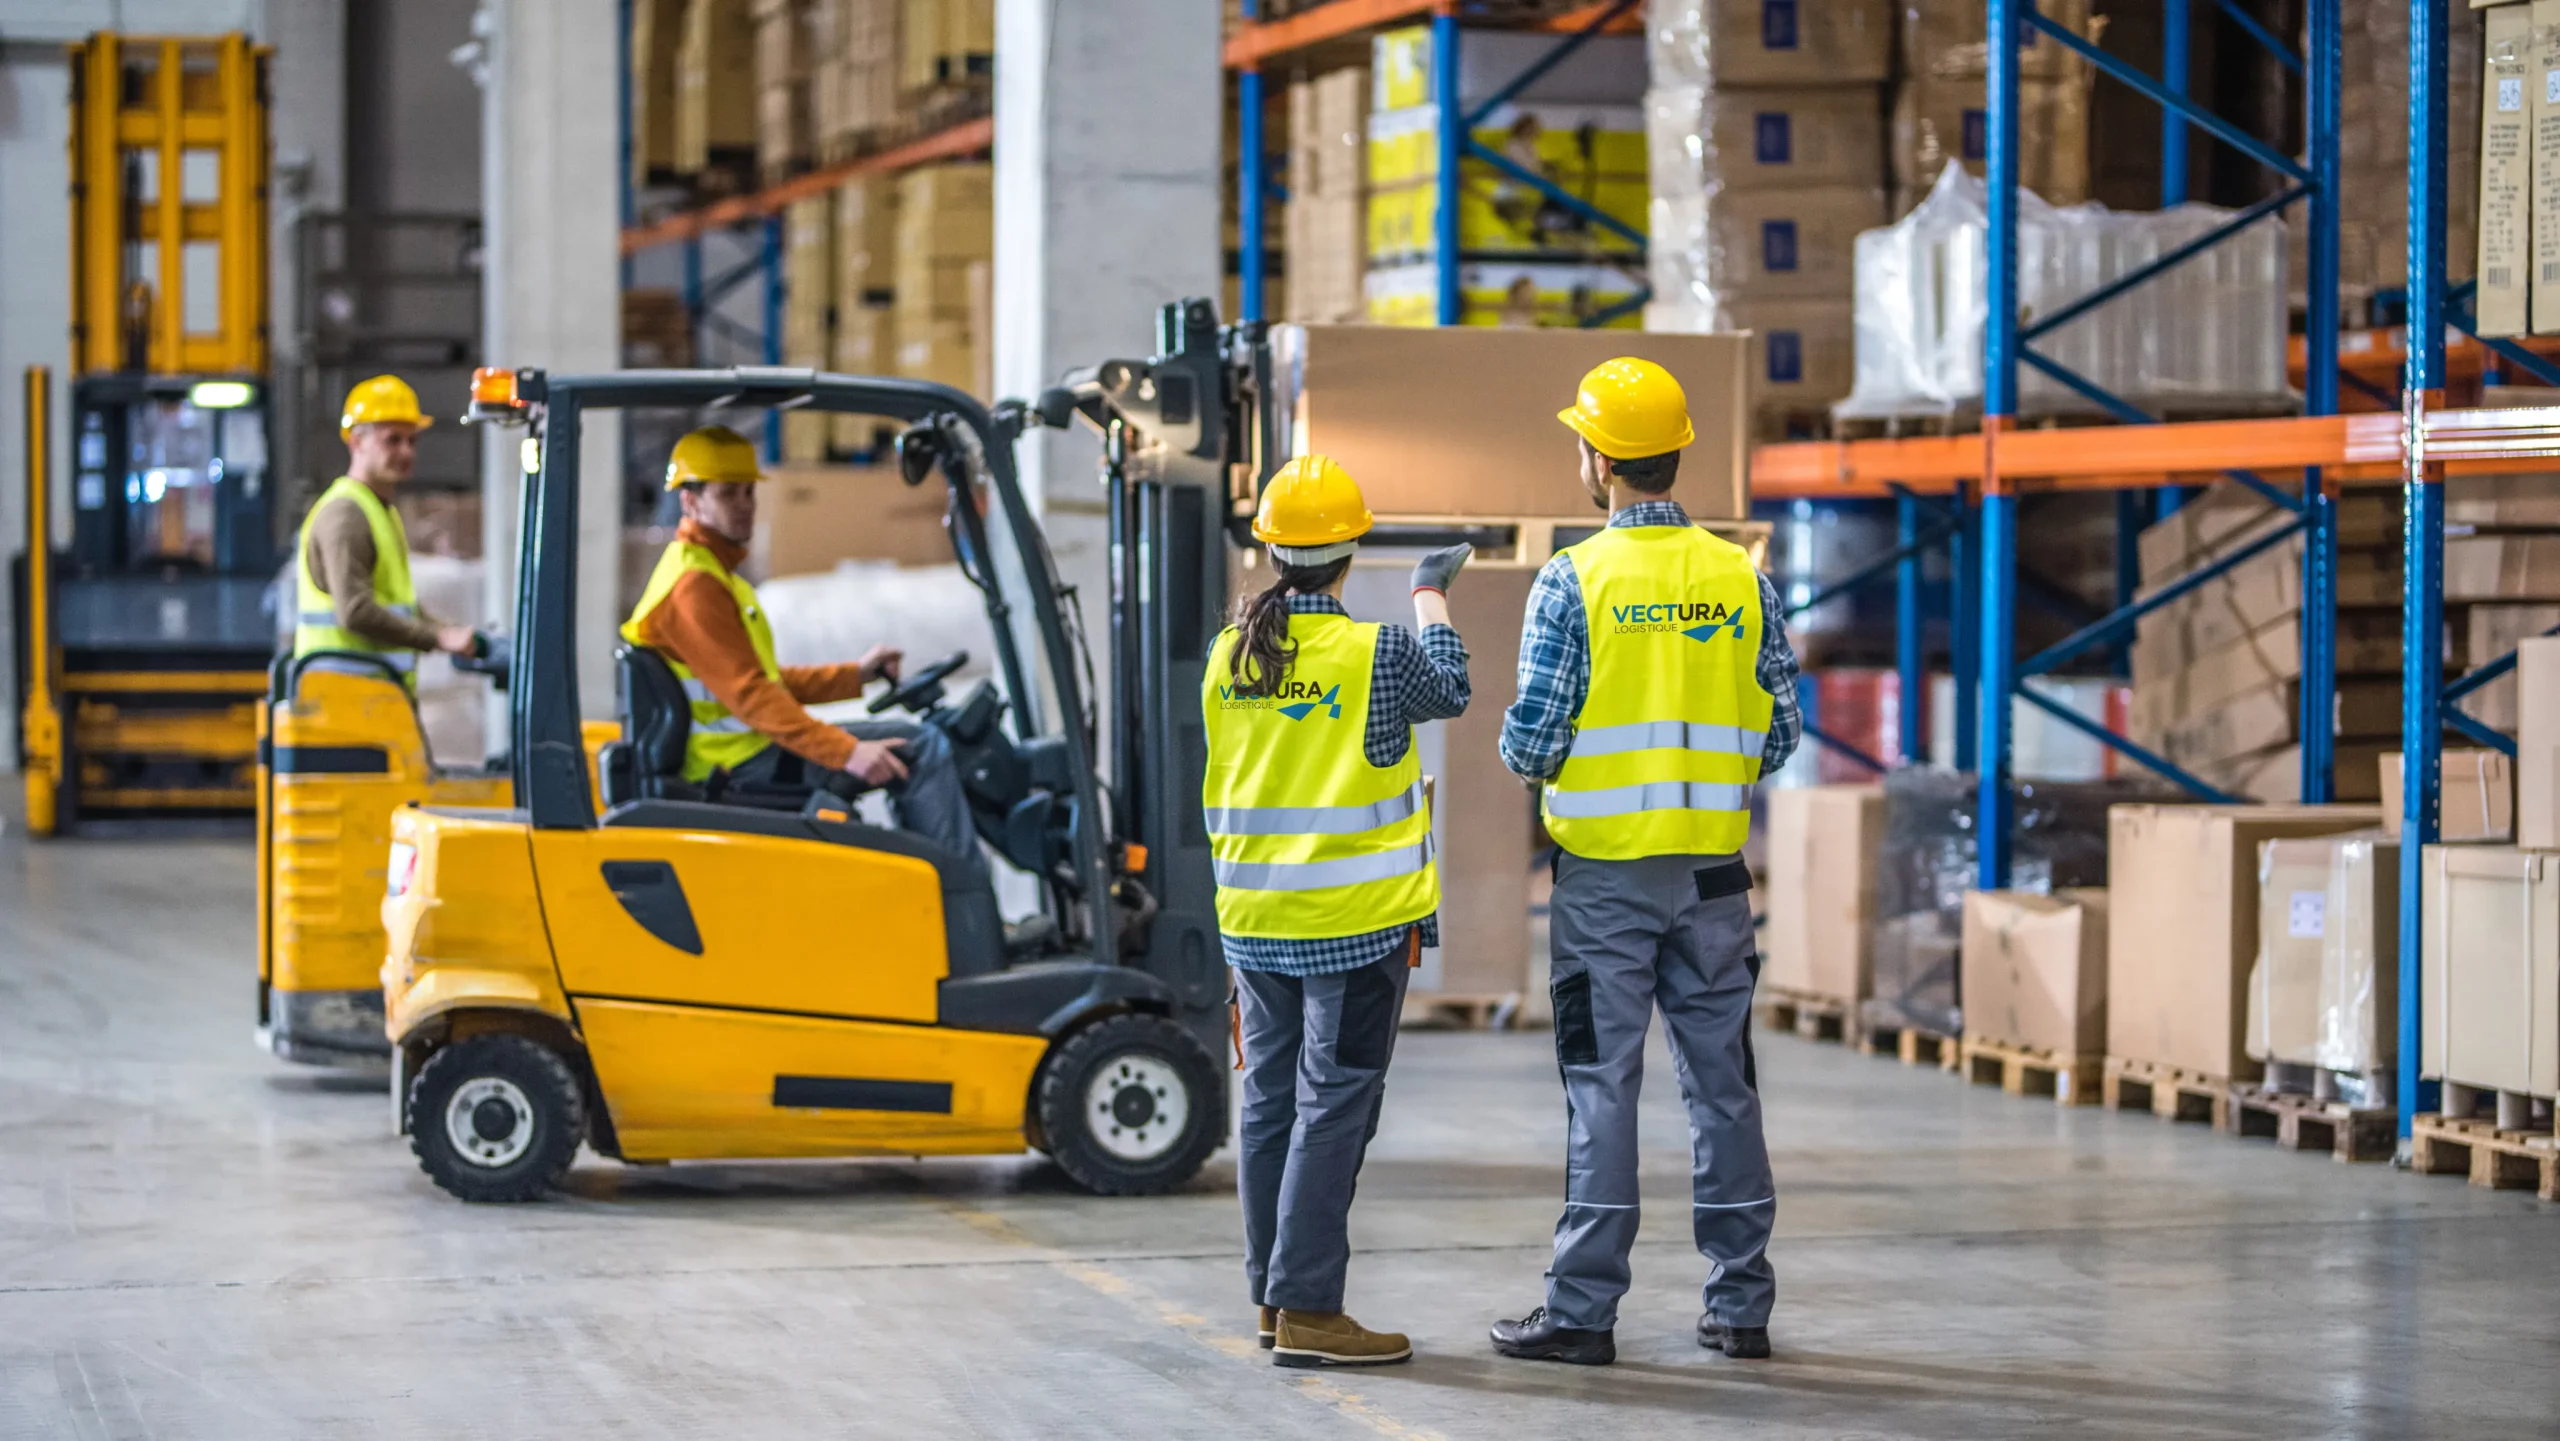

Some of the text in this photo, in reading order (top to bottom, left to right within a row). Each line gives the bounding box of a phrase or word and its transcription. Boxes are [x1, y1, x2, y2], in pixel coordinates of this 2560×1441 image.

[1612, 603, 1728, 623] VECTURA
[1614, 624, 1678, 634] LOGISTIQUE
[1220, 701, 1274, 710] LOGISTIQUE
